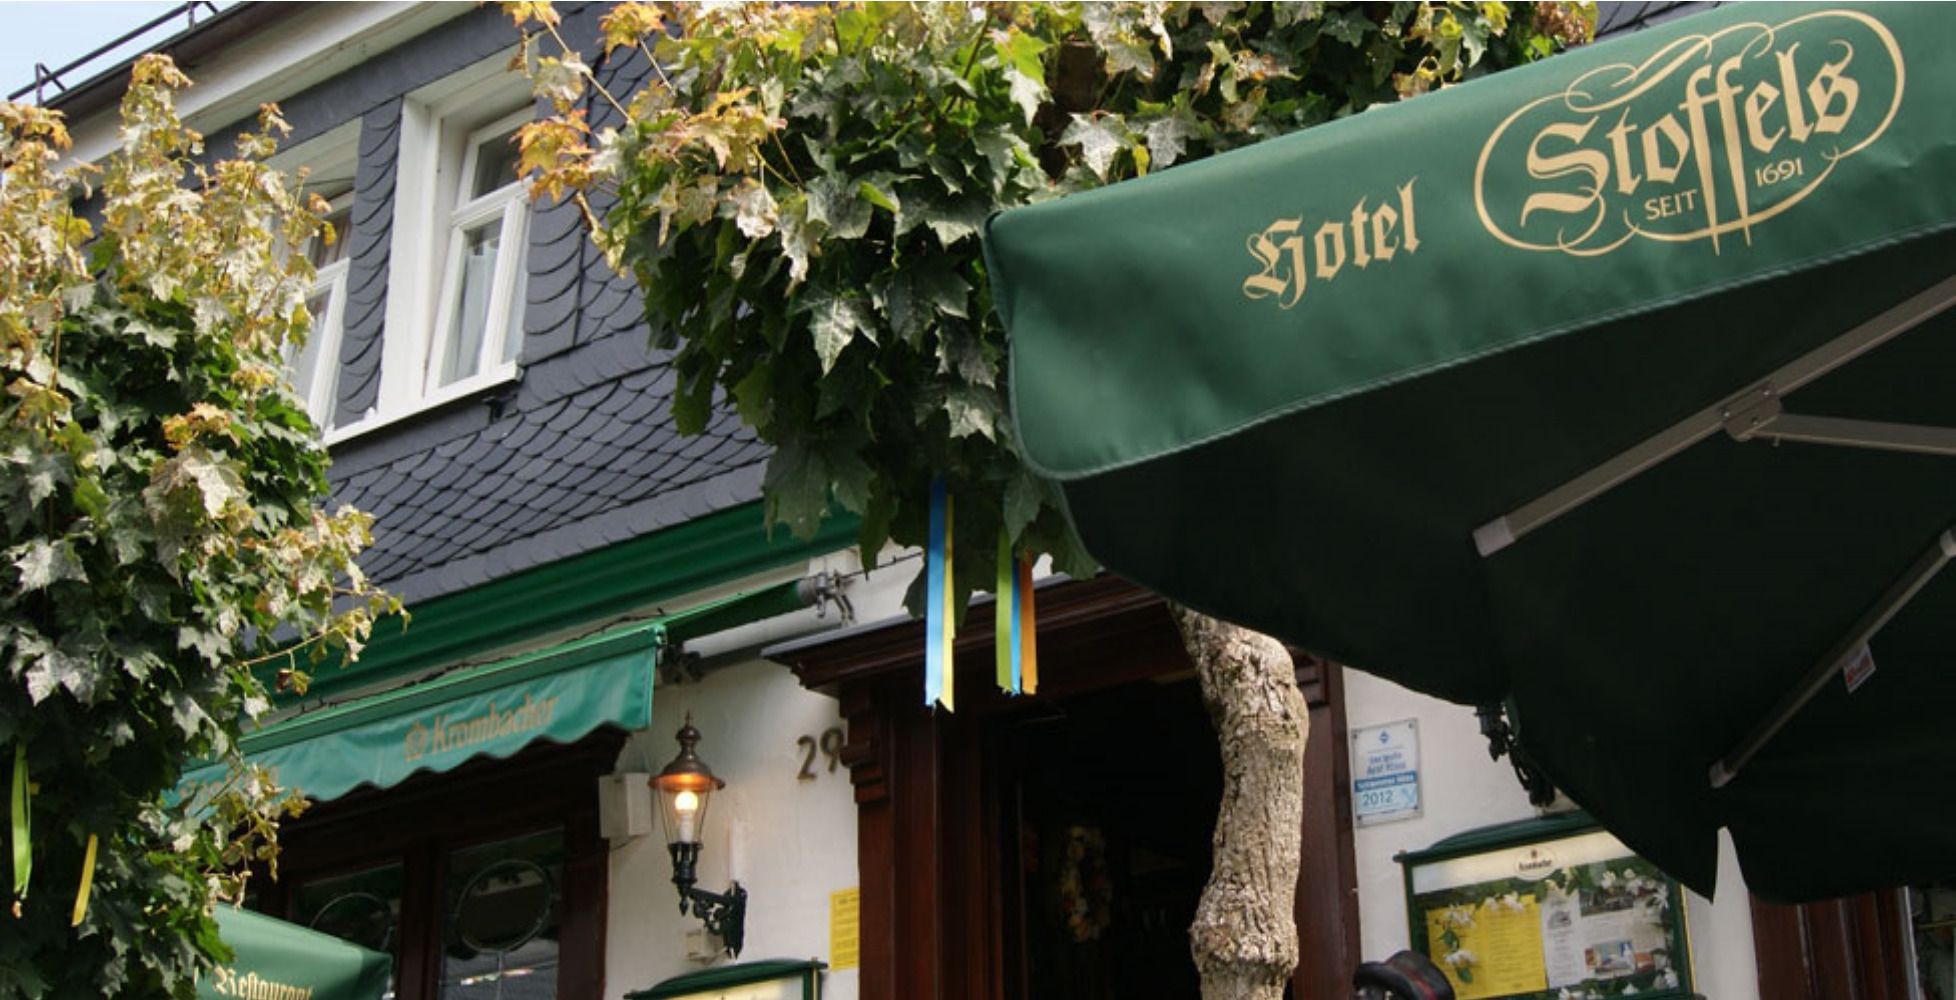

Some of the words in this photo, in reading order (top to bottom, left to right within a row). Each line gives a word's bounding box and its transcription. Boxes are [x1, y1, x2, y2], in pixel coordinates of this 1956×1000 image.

[1243, 176, 1419, 309] Hotel
[1519, 39, 1859, 256] Stoffels
[1644, 188, 1698, 221] SEIT
[1754, 158, 1804, 187] 1691
[431, 692, 560, 754] Krombacher
[796, 727, 844, 781] 29
[1363, 790, 1393, 806] 2012
